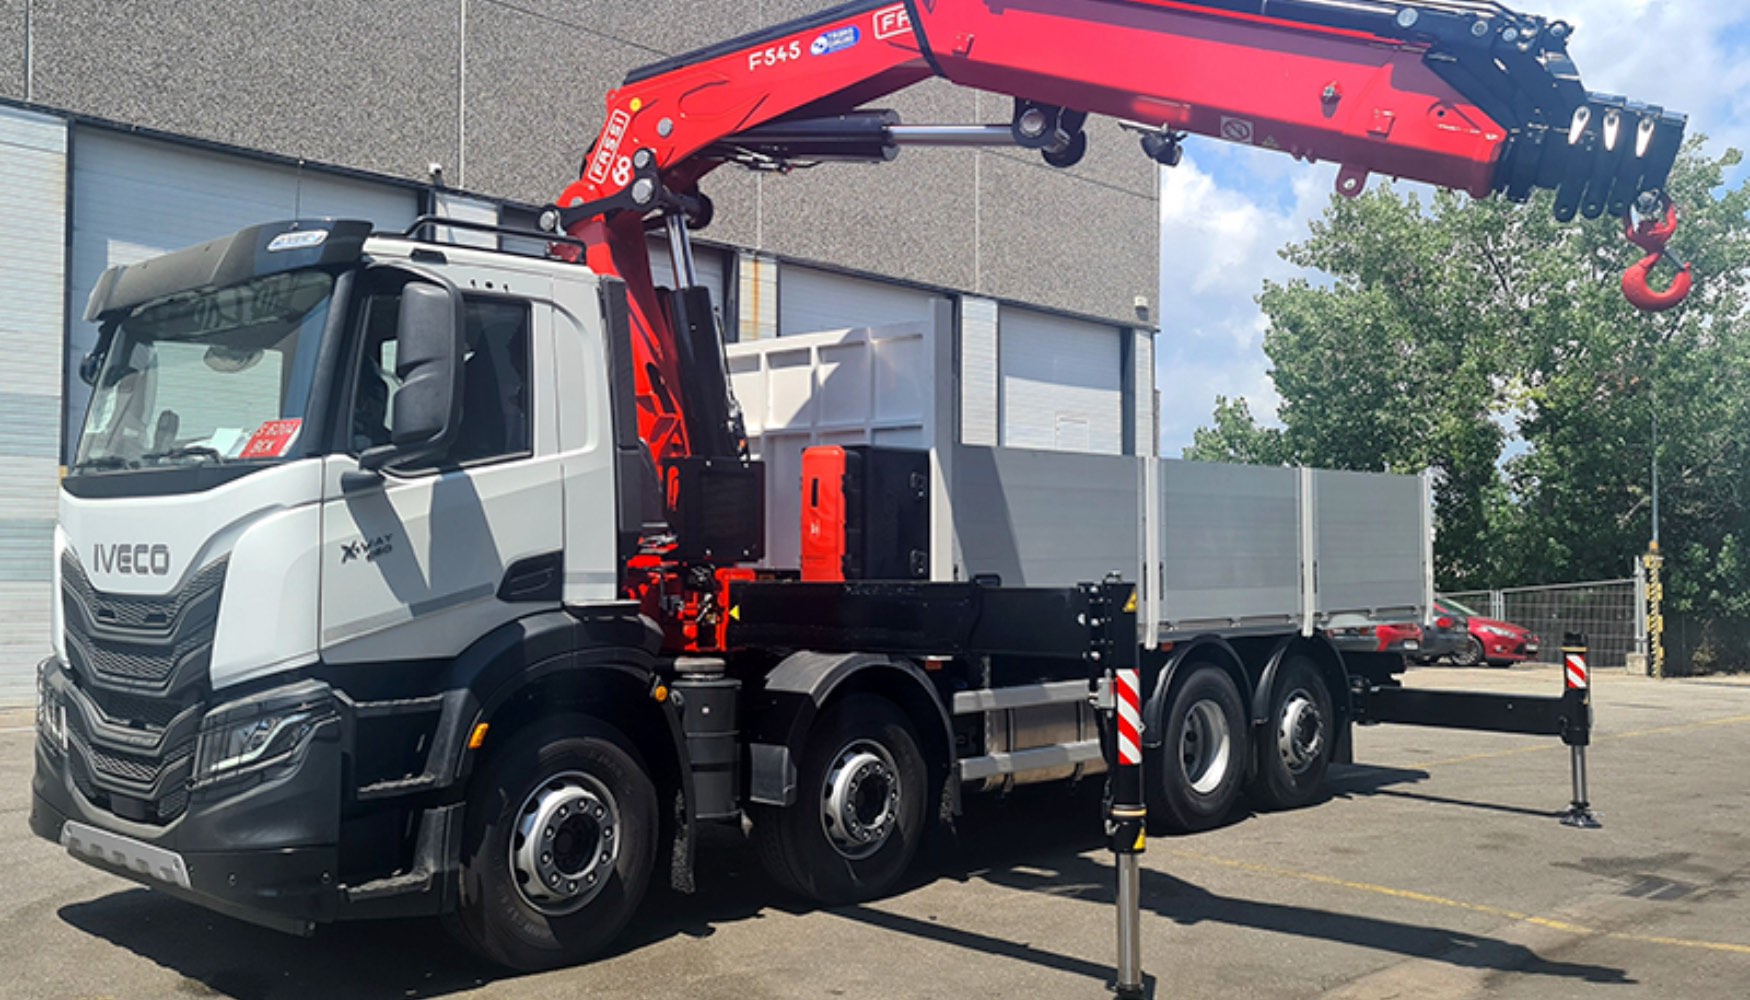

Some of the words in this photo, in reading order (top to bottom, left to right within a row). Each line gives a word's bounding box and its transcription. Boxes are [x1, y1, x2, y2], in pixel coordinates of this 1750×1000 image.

[748, 40, 801, 71] F545
[593, 117, 624, 177] FASSI
[94, 544, 169, 575] IVECO
